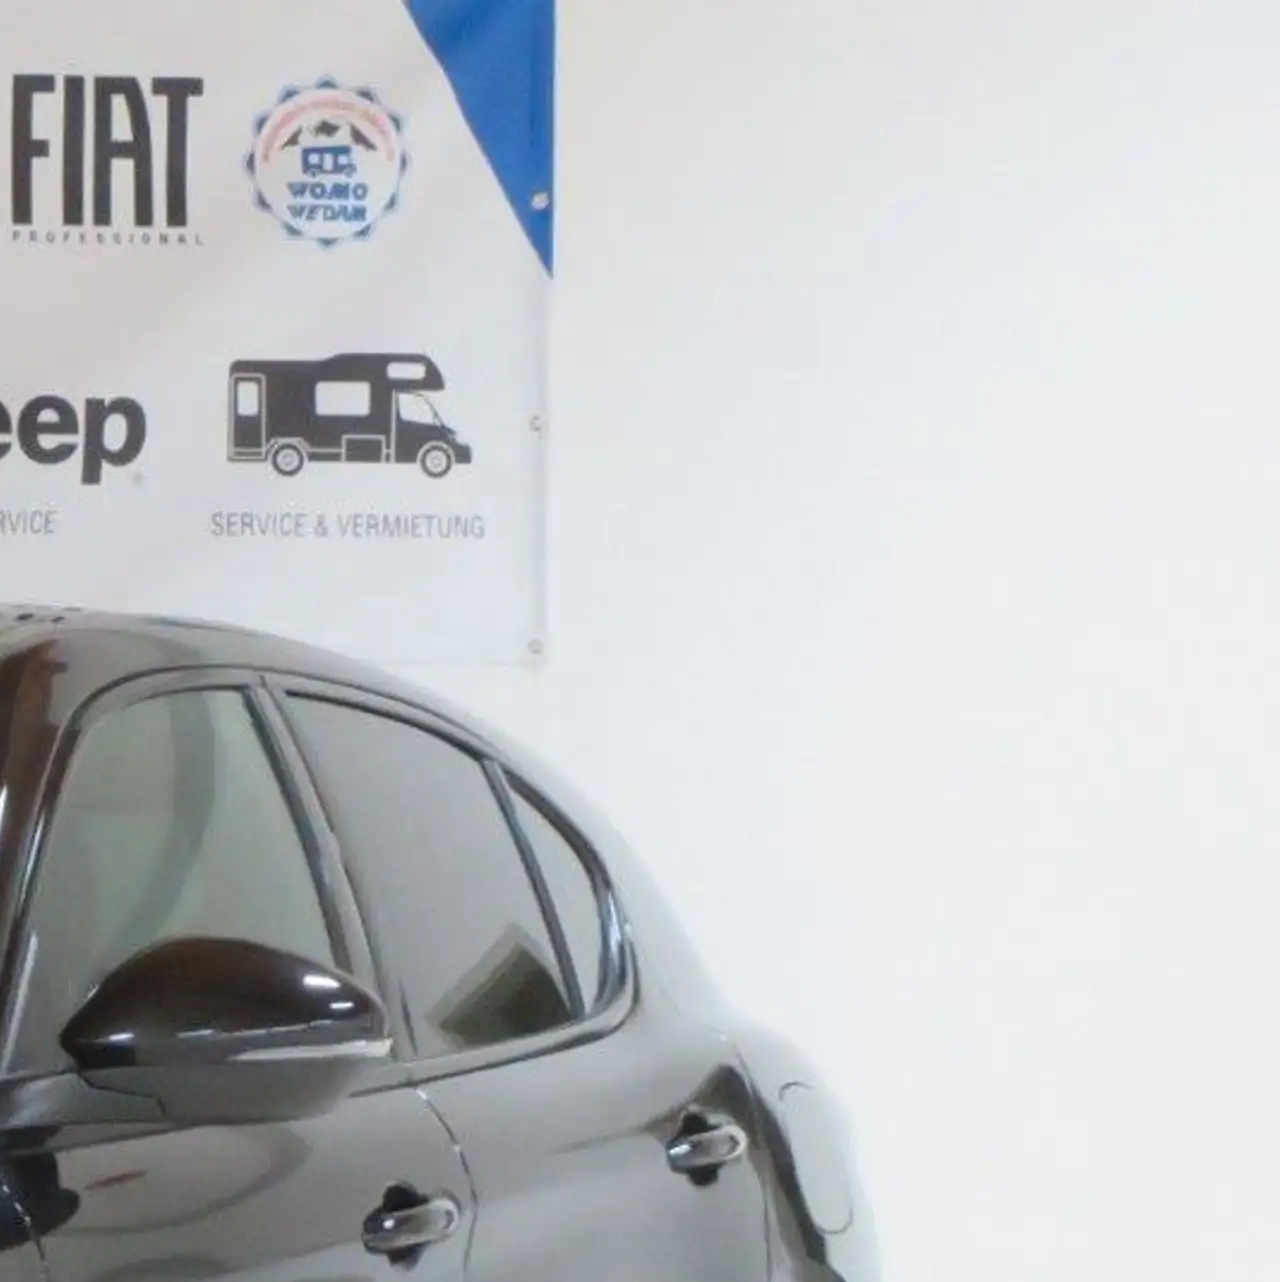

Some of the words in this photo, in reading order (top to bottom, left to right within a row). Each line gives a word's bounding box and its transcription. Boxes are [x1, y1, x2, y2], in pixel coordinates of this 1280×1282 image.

[11, 74, 204, 227] FIAT
[286, 181, 368, 200] WOMO
[286, 203, 367, 223] WEDAM
[12, 230, 205, 247] PROFESSIONAL
[210, 511, 307, 538] SERVICE
[313, 515, 329, 538] &
[337, 514, 486, 540] VERMIETUNG
